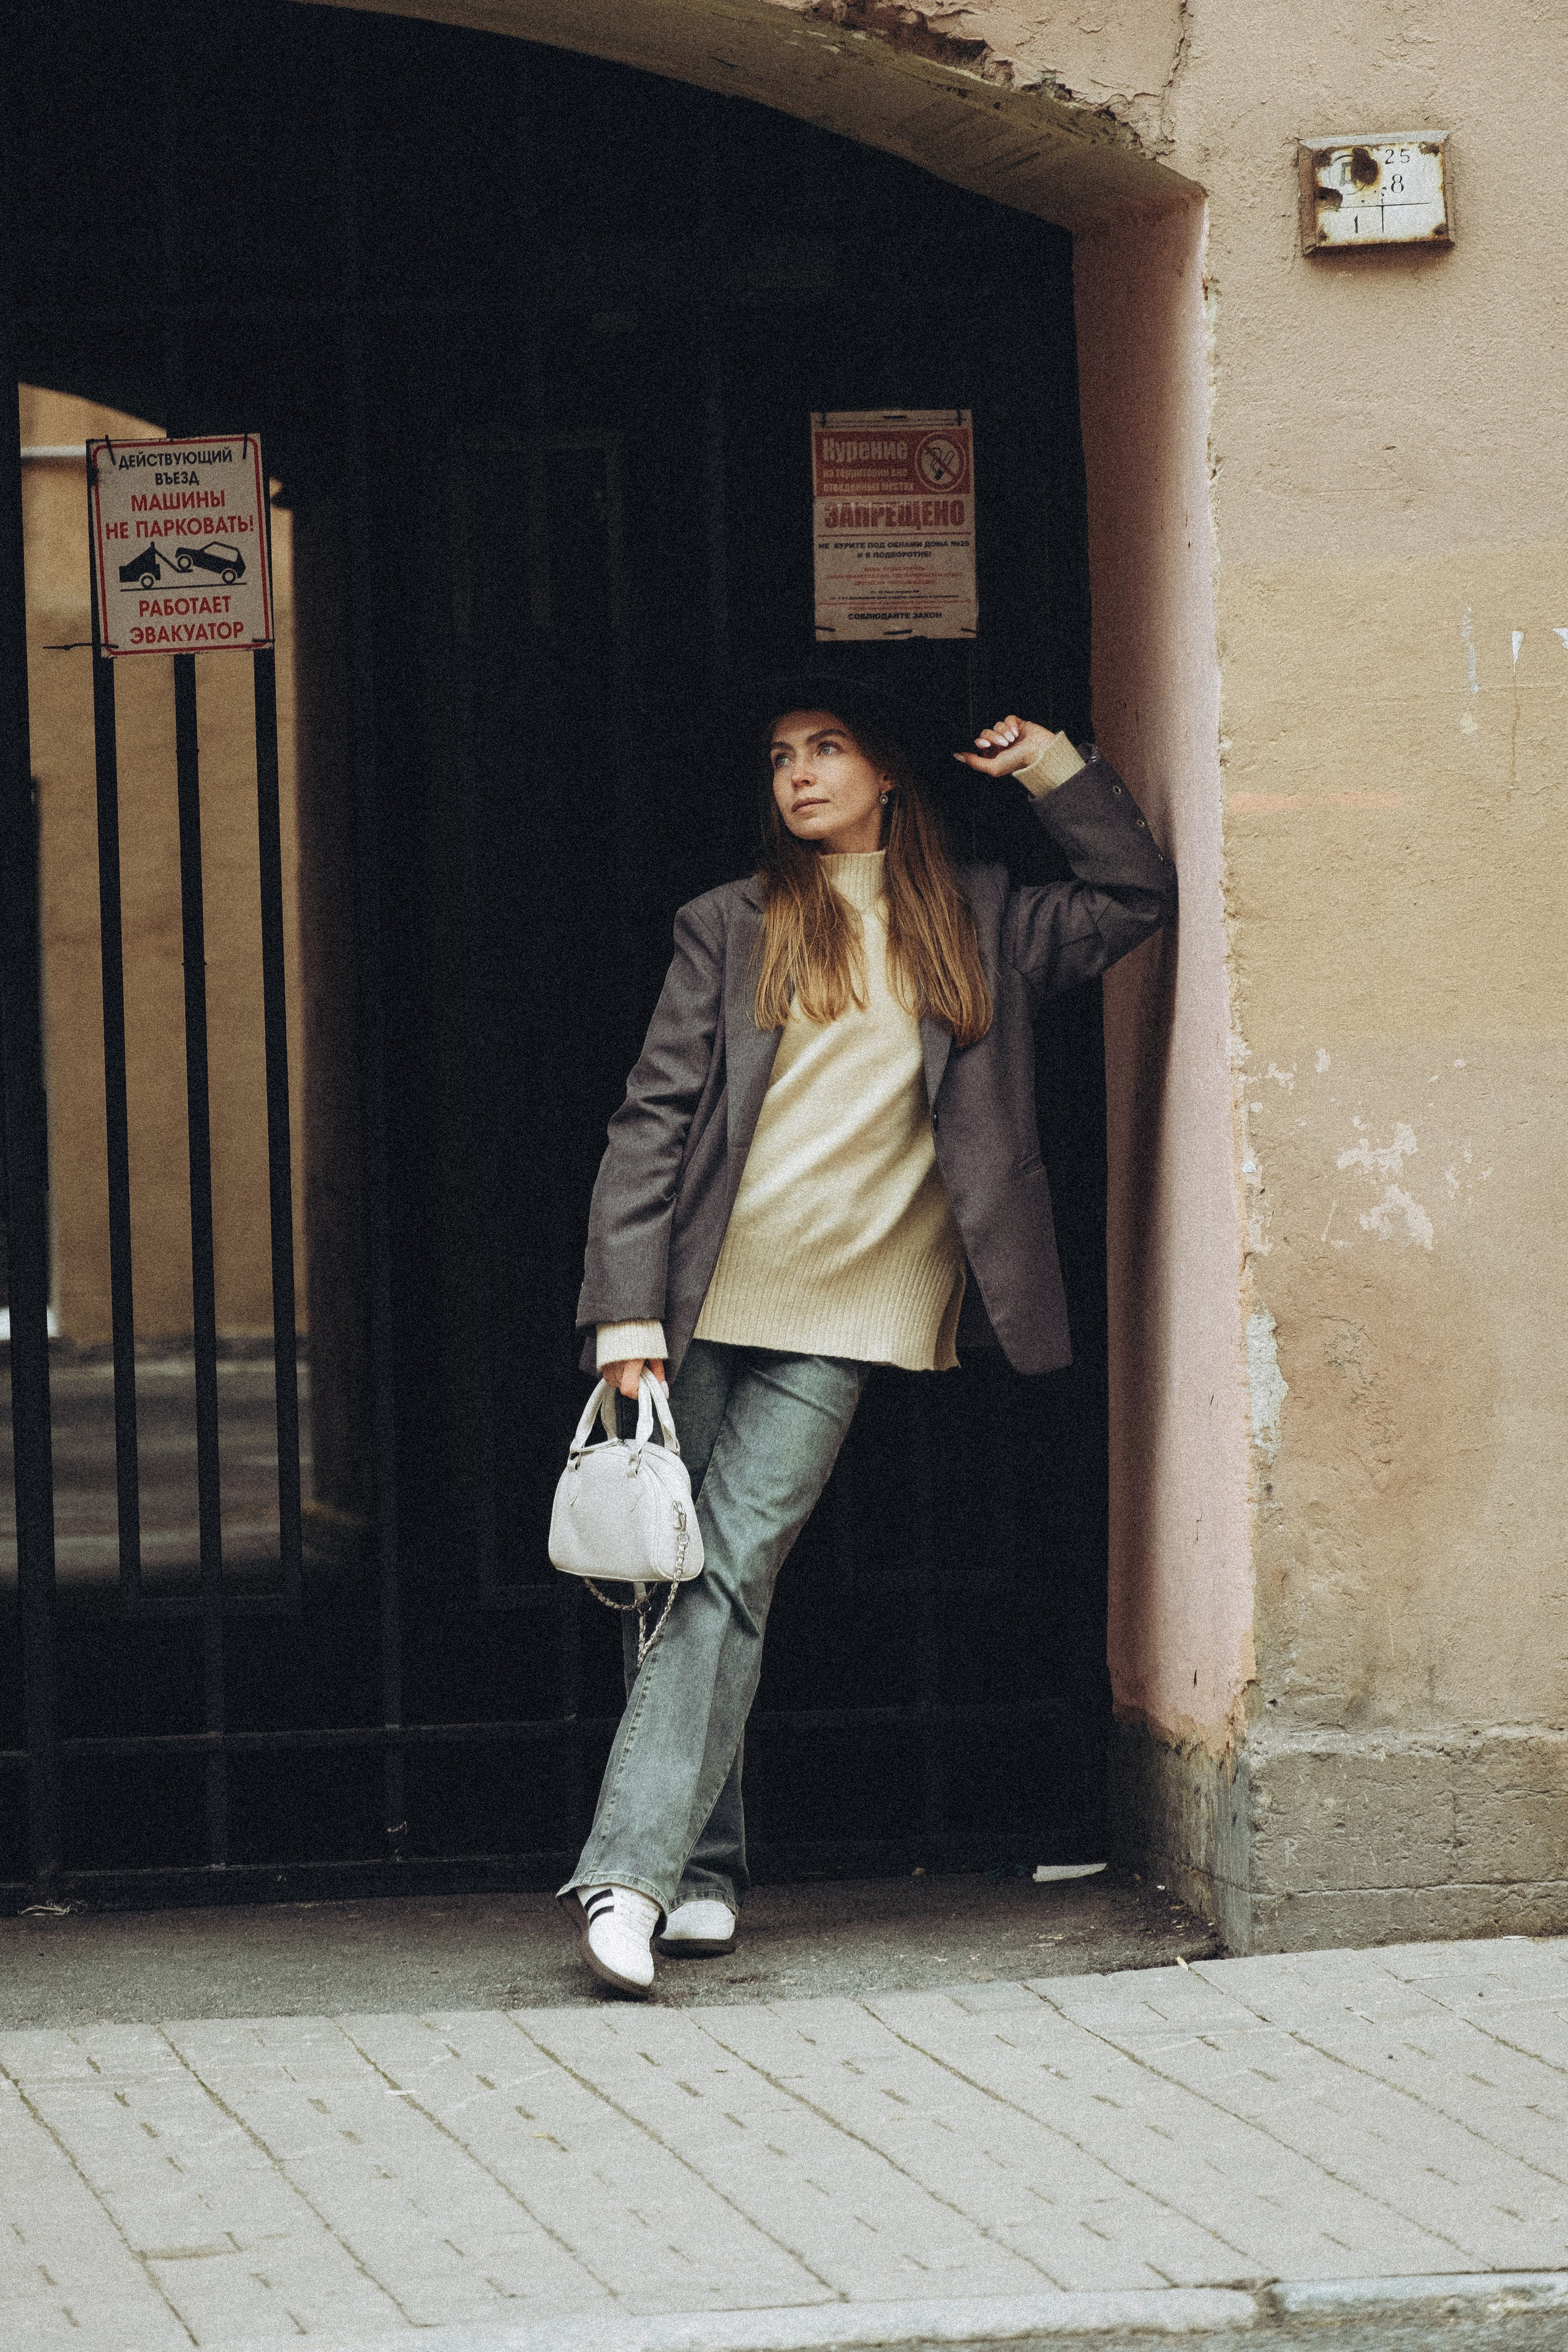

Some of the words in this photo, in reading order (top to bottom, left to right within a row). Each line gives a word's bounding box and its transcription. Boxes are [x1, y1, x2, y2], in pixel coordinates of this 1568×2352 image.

[1385, 149, 1410, 164] 25
[118, 447, 233, 470] ДЕЙСТВУЮЩИЙ
[822, 438, 908, 463] Курение
[155, 471, 200, 486] ВЪЕЗД
[130, 490, 225, 511] МАШИНЫ
[824, 500, 965, 530] ЗАПРЕЩЕНО
[105, 522, 129, 540] НЕ
[136, 515, 254, 538] ПАРКОВАТЬ!
[138, 595, 232, 617] РАБОТАЕТ
[848, 611, 910, 620] СОБЛЮДАЙТЕ
[129, 621, 244, 644] ЭВАКУАТОР
